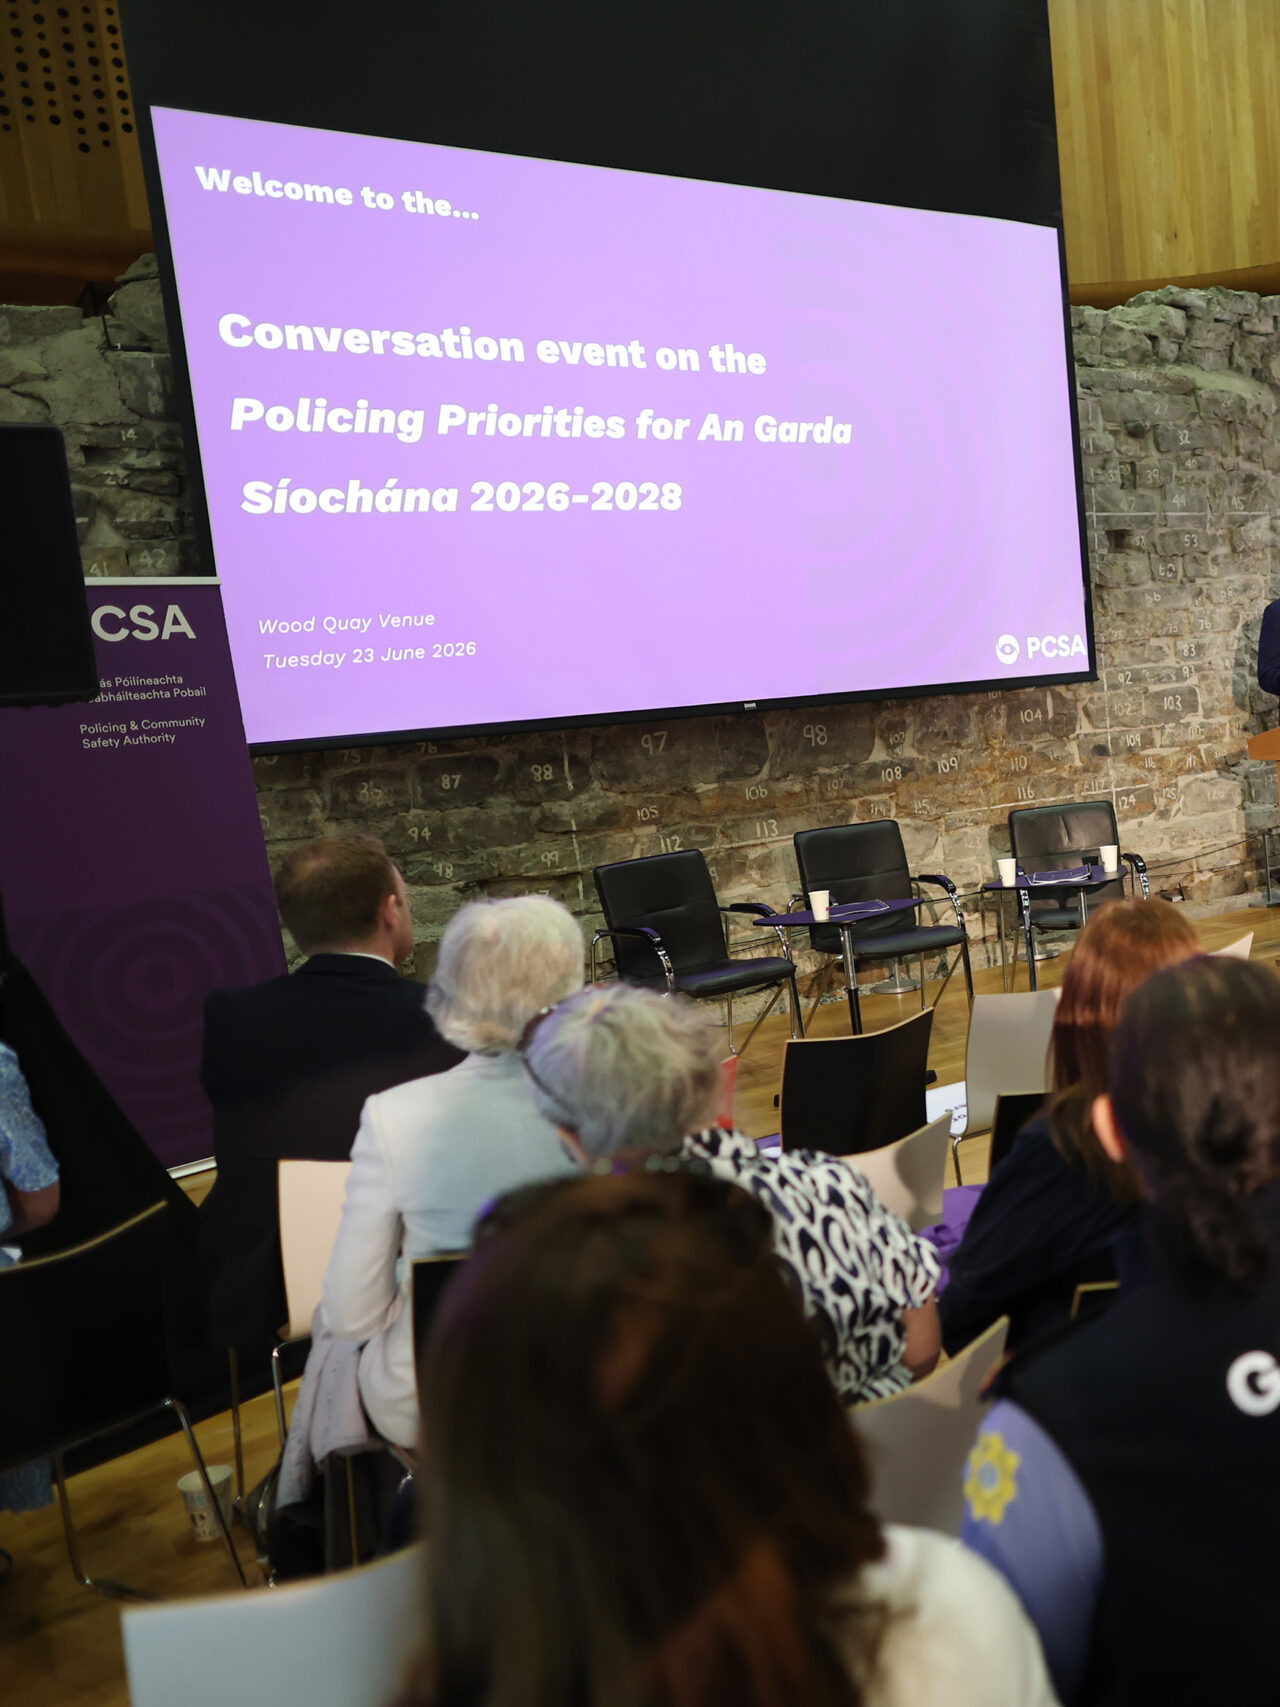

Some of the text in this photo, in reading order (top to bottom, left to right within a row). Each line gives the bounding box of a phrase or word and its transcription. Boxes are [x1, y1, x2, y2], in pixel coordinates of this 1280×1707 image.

[194, 166, 480, 220] Welcome to the...
[218, 313, 767, 375] Conversation event on the
[230, 397, 853, 445] Policing Priorities for An Garda
[240, 478, 683, 514] Síochána 2026-2028
[1184, 534, 1199, 547] 53
[90, 604, 197, 642] CSA
[259, 614, 435, 634] Wood Quay Venue
[263, 641, 476, 669] Tuesday 23 June 2026
[1026, 633, 1087, 660] PCSA
[1183, 643, 1196, 657] 83
[115, 674, 184, 688] Póilíneachta
[1118, 671, 1133, 686] 92
[173, 686, 207, 699] Pobail
[1163, 694, 1182, 711] 103
[1019, 708, 1044, 723] 104
[79, 716, 206, 735] Policing & Community
[82, 732, 176, 750] Safety Authority
[641, 730, 668, 756] 97
[803, 724, 829, 748] 98
[1126, 732, 1141, 747] 109
[937, 757, 959, 775] 109
[1009, 755, 1028, 772] 110
[441, 773, 462, 790] 87
[881, 766, 903, 783] 108
[745, 784, 768, 801] 106
[1017, 781, 1036, 800] 116
[636, 804, 659, 821] 105
[407, 826, 432, 842] 94
[756, 819, 780, 838] 113
